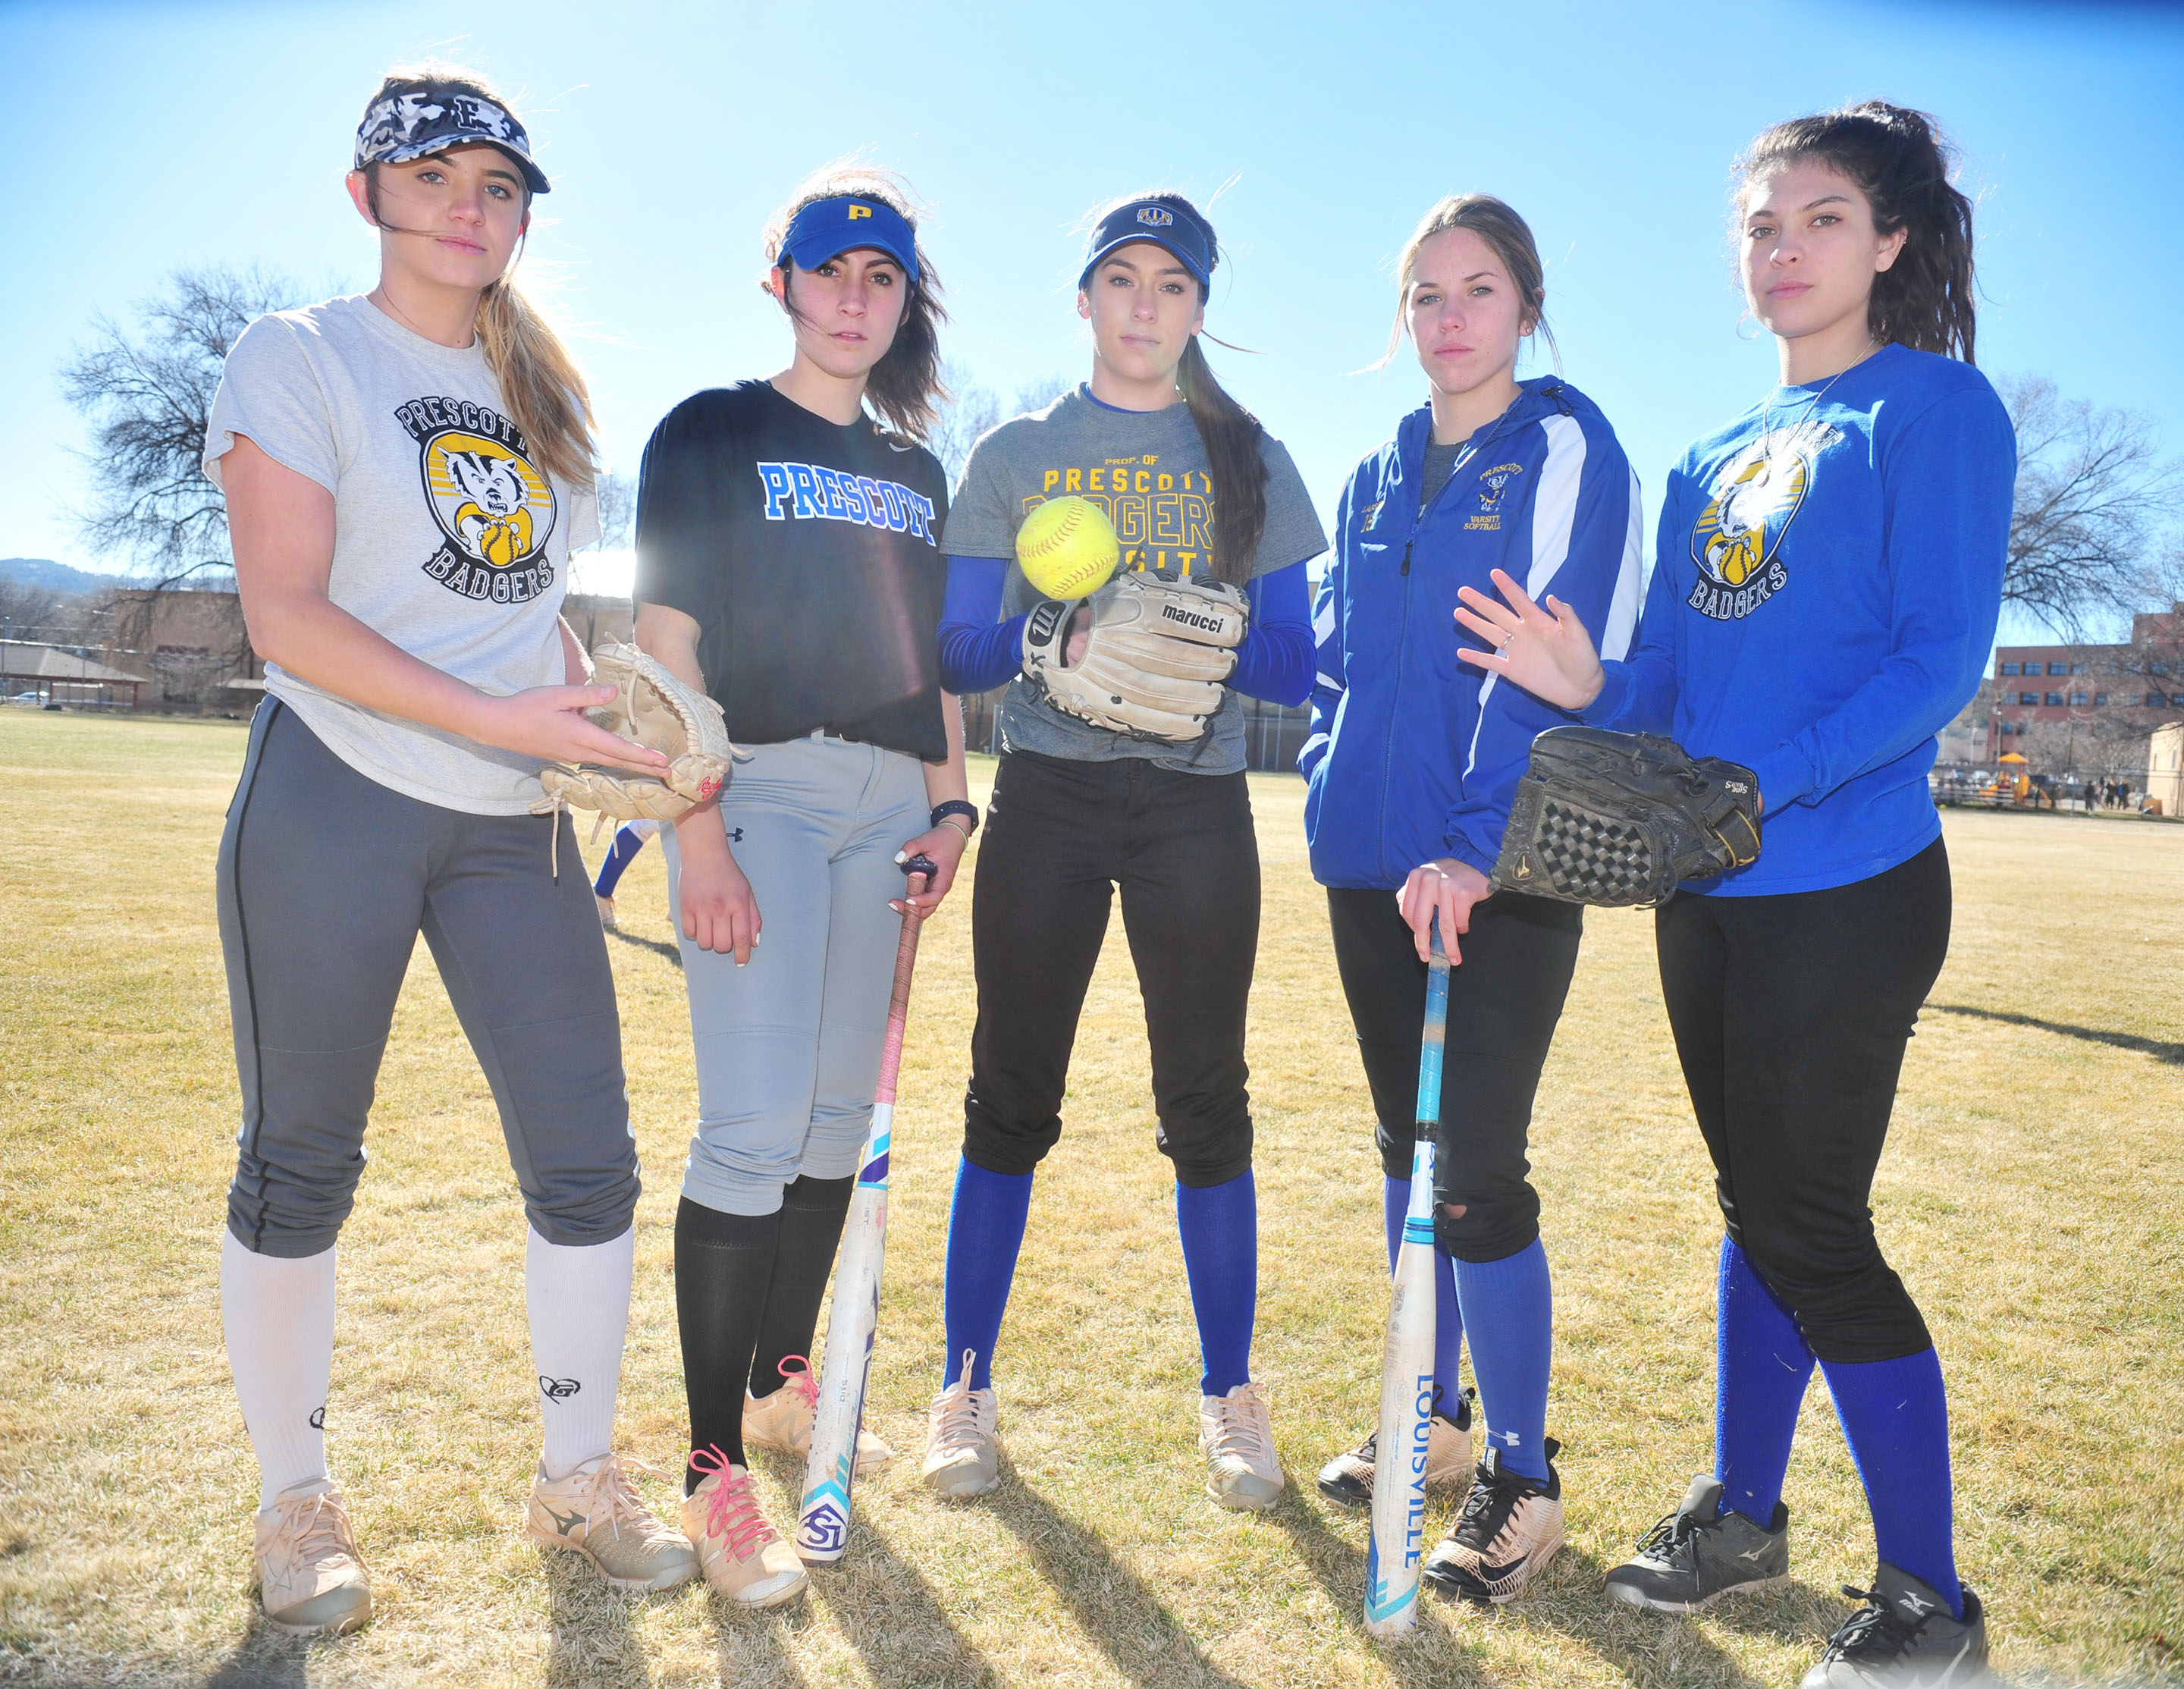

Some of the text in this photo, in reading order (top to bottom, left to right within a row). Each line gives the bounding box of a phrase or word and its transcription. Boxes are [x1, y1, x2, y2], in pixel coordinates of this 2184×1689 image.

[847, 204, 872, 220] P
[1143, 455, 1159, 465] OF
[1480, 463, 1523, 481] PRESCOTT
[757, 461, 937, 547] PRESCOTT
[1464, 522, 1501, 531] SOFTBALL
[1470, 515, 1501, 523] VARSITY
[422, 547, 554, 604] BADGERS
[1687, 562, 1788, 620] BADGERS
[1162, 604, 1225, 634] marucci
[1404, 1374, 1434, 1570] LOUISVILLE
